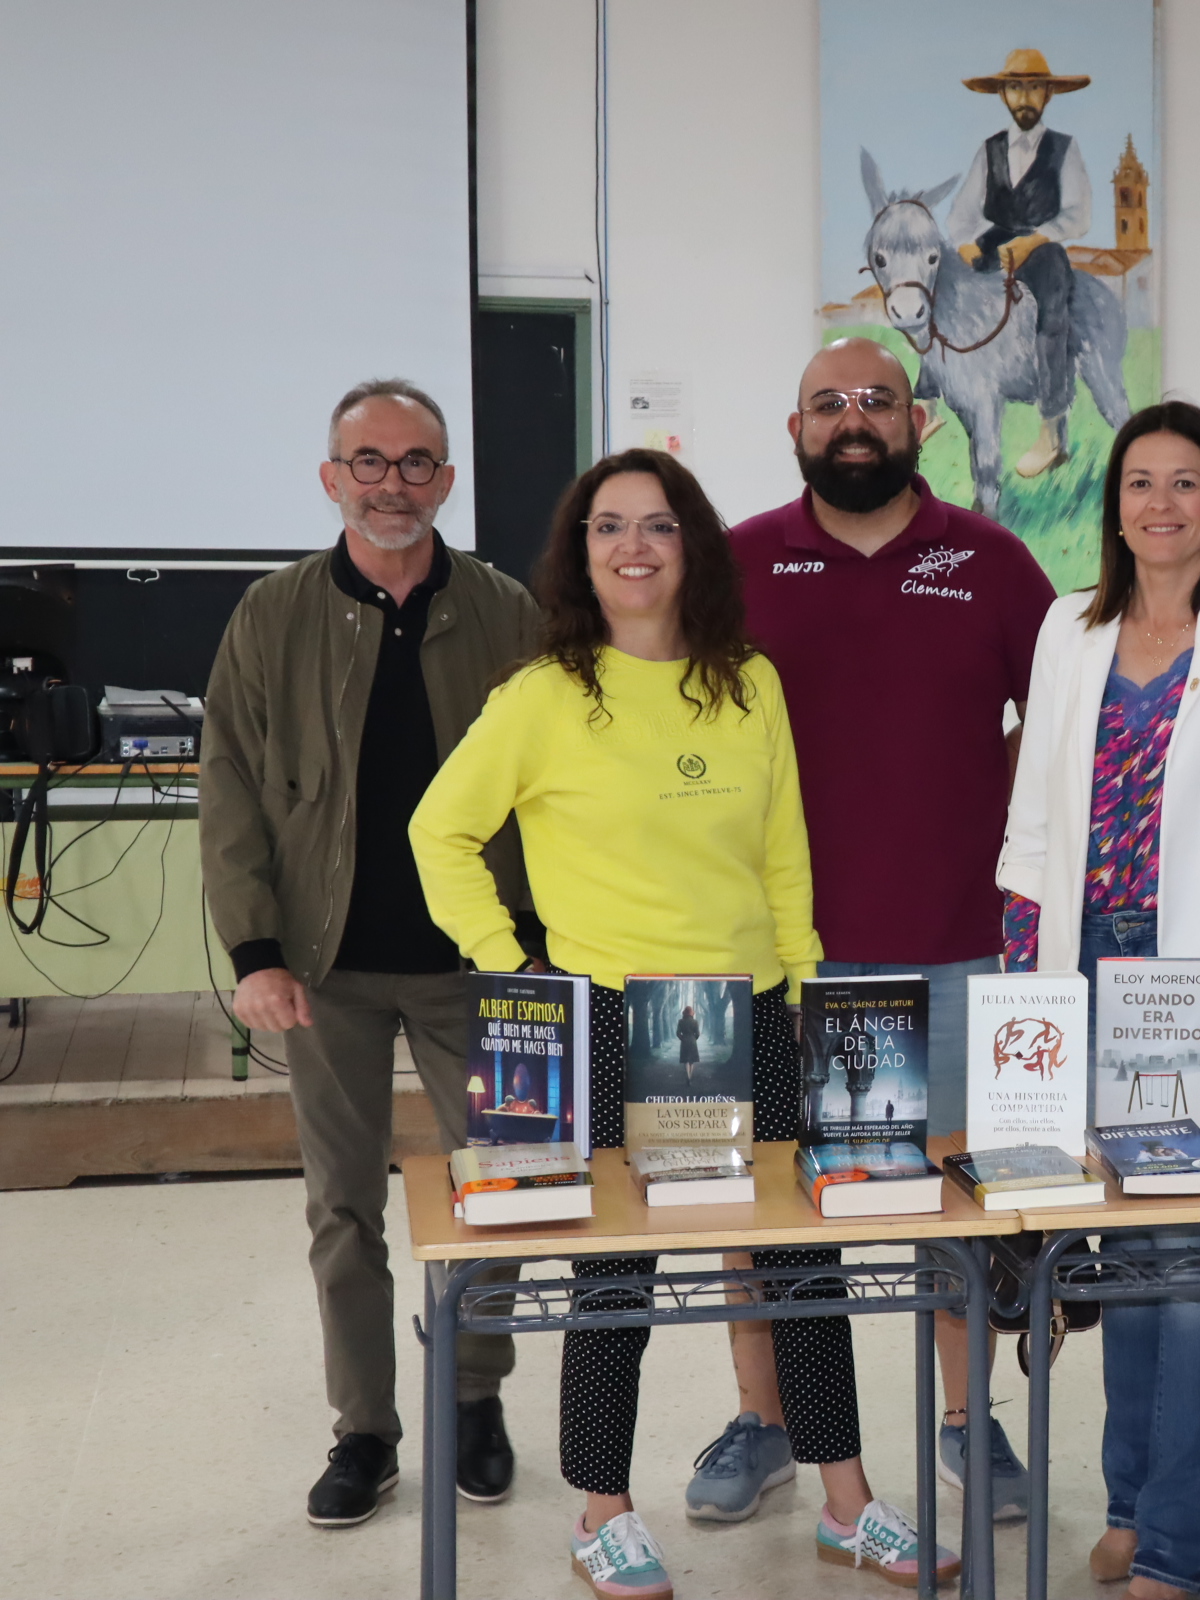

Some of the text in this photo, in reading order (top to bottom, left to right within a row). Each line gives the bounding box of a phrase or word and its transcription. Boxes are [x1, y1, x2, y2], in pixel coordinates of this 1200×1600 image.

[901, 579, 973, 601] Clemente
[676, 790, 699, 798] SINCE
[701, 786, 742, 795] TWELVE-75
[1114, 974, 1145, 984] ELOY
[852, 999, 876, 1008] SÁENZ
[878, 1000, 887, 1008] DE
[889, 999, 914, 1007] URTURI
[981, 994, 1076, 1005] JULIA NAVARRO
[1122, 993, 1195, 1006] CUANDO
[479, 998, 565, 1023] ALBERT ESPINOSA
[1143, 1010, 1175, 1023] ERA
[825, 1013, 914, 1033] EL ÁNGEL
[488, 1020, 556, 1040] QUÉ BIEN ME HACES
[481, 1037, 563, 1056] CUANDO ME HACES BIEN
[844, 1035, 895, 1051] DE LA
[832, 1052, 906, 1070] CIUDAD
[988, 1092, 1068, 1100] UNA HISTORIA
[657, 1109, 728, 1119] LA VIDA QUE
[991, 1103, 1064, 1112] COMPARTIDA
[658, 1120, 727, 1129] NOS SEPARA
[1100, 1126, 1192, 1140] DIFERENTE
[478, 1155, 571, 1169] Sapiens
